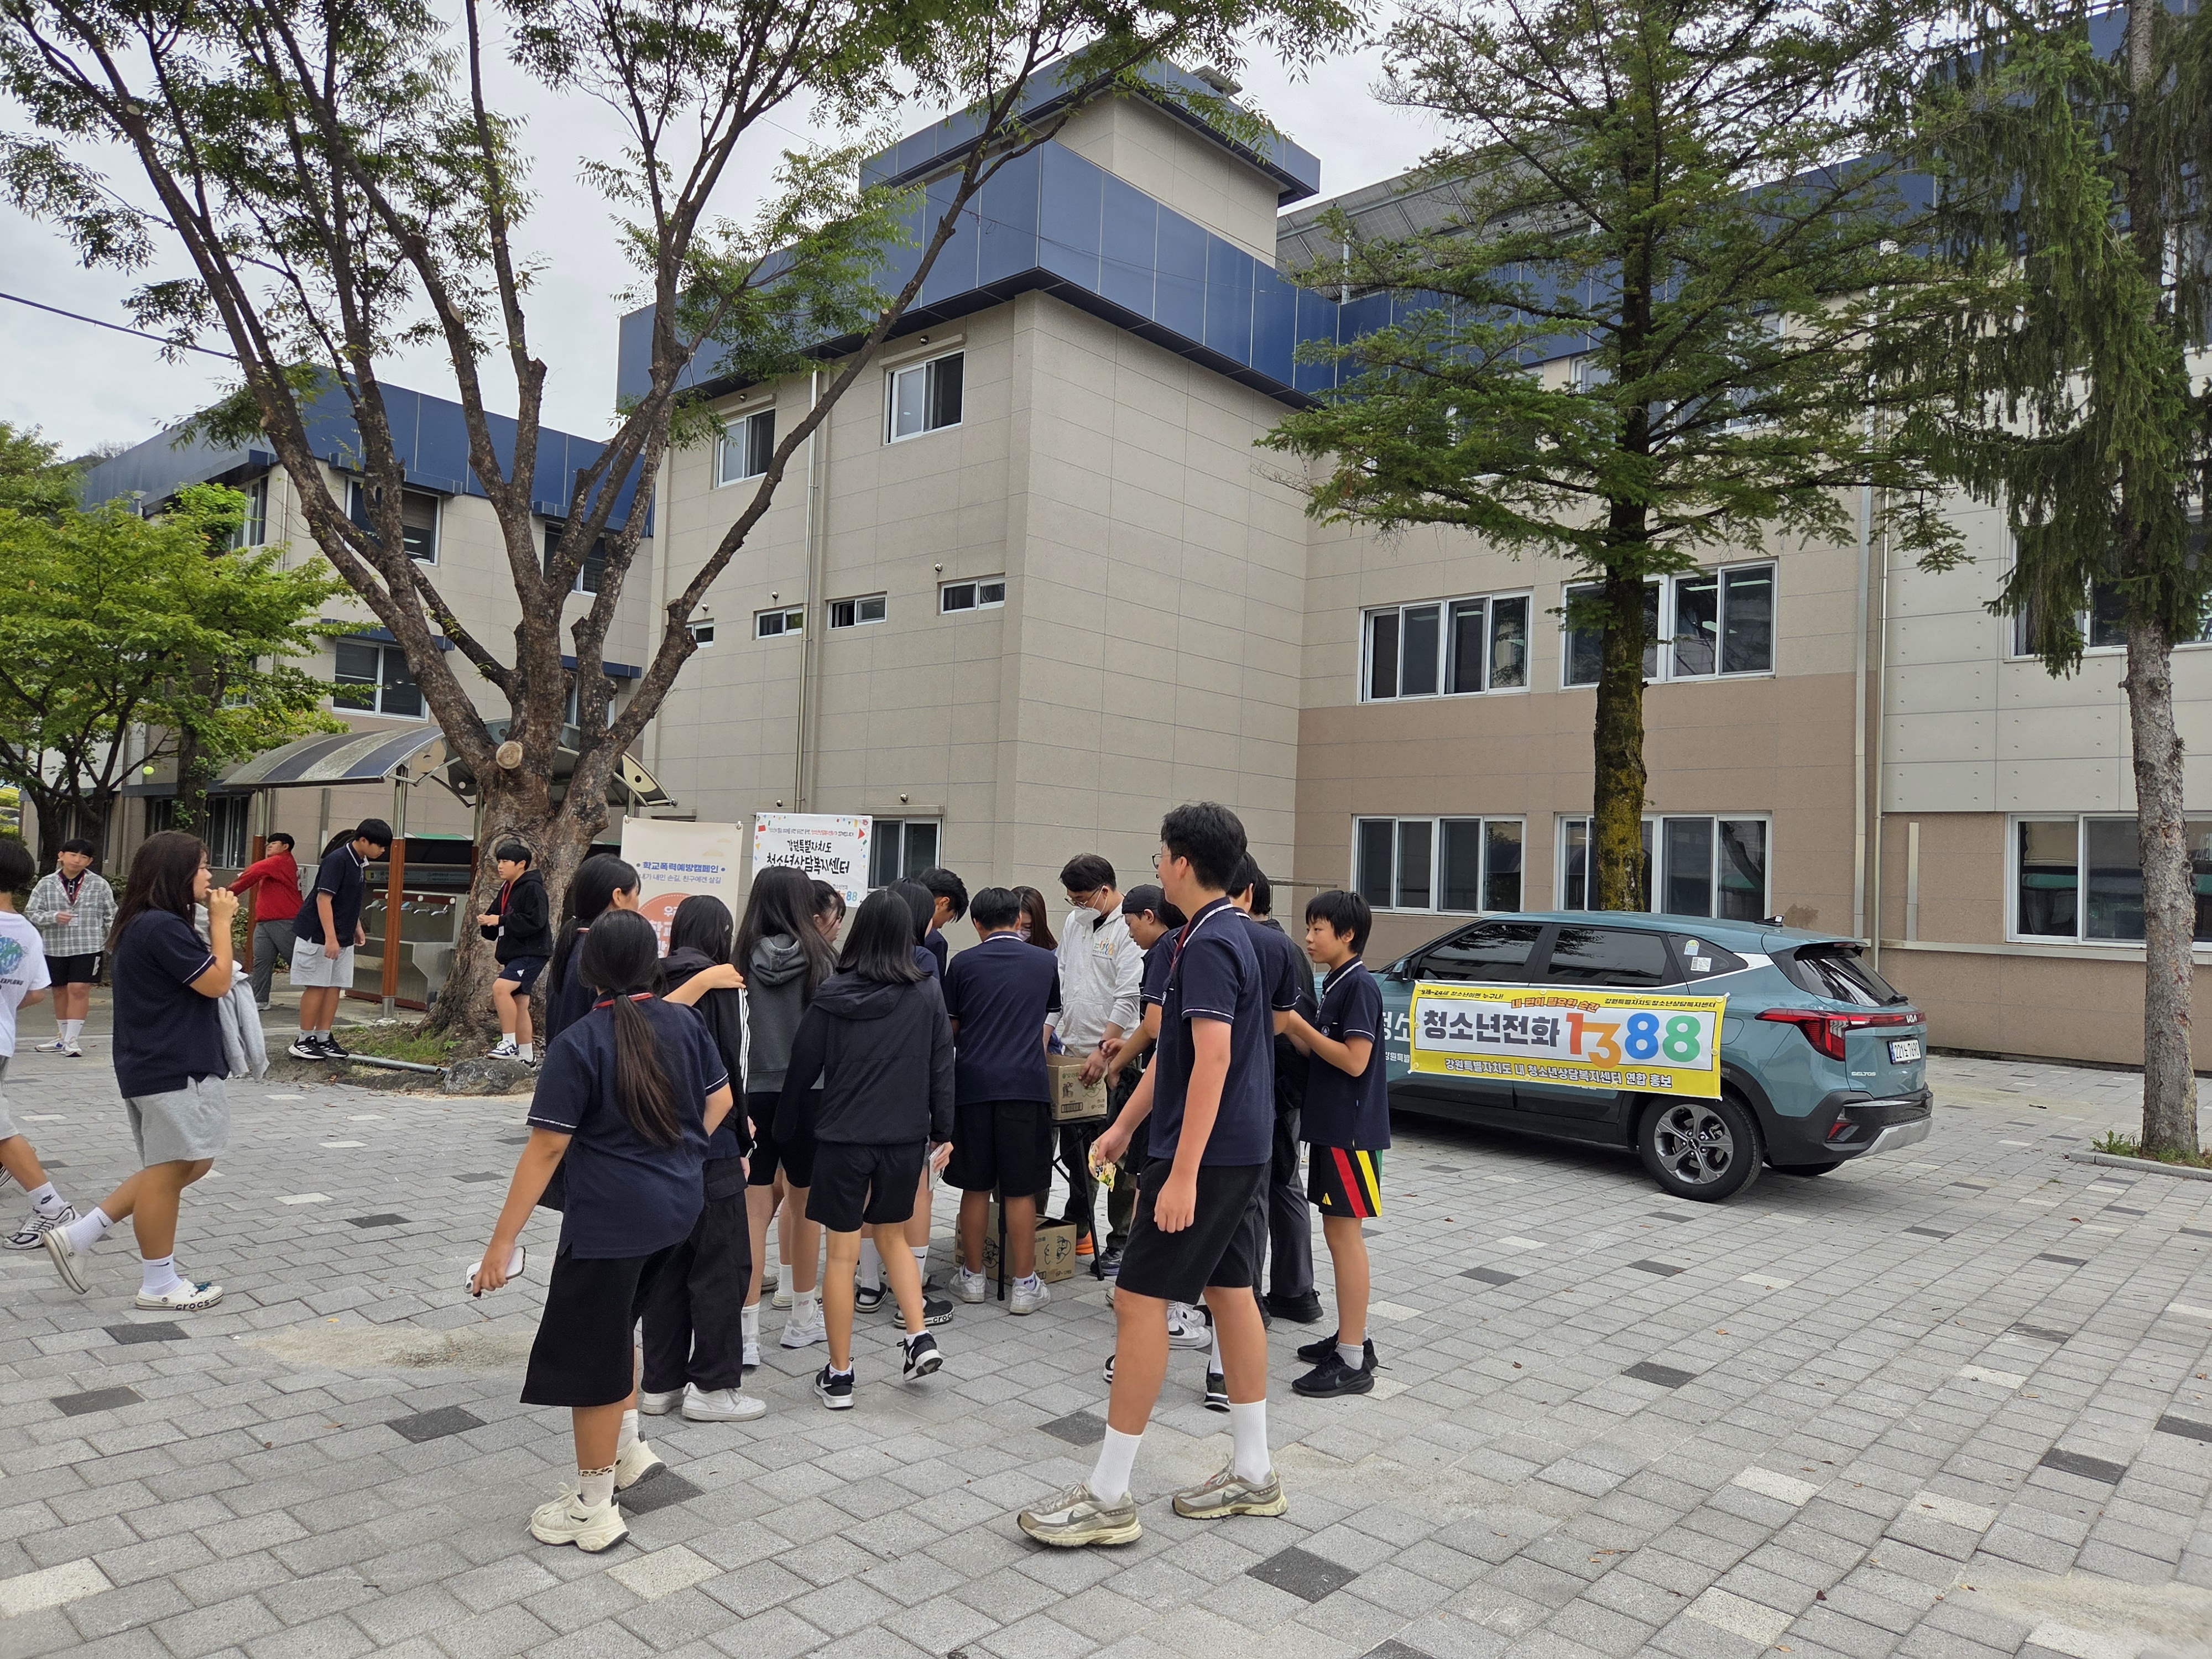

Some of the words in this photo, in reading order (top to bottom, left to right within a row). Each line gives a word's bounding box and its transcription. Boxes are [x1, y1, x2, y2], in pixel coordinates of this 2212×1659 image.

[787, 839, 832, 853] 강원특별자치도
[643, 861, 719, 873] 학교폭력예방캠페인
[1511, 998, 1522, 1009] 내
[1525, 997, 1545, 1007] 편이
[1547, 997, 1578, 1008] 필요한
[1577, 1001, 1600, 1013] 순간
[1605, 999, 1716, 1008] 강원특별자치도청소년상담복지센터
[1423, 1010, 1560, 1047] 청소년전화
[1566, 1013, 1701, 1068] 1388
[1445, 1058, 1512, 1074] 강원특별자치도
[1515, 1063, 1525, 1076] 내
[1527, 1065, 1622, 1084] 청소년상담복지센터
[1625, 1072, 1646, 1086] 연합
[1650, 1073, 1672, 1088] 홍보
[175, 1300, 210, 1311] crocs
